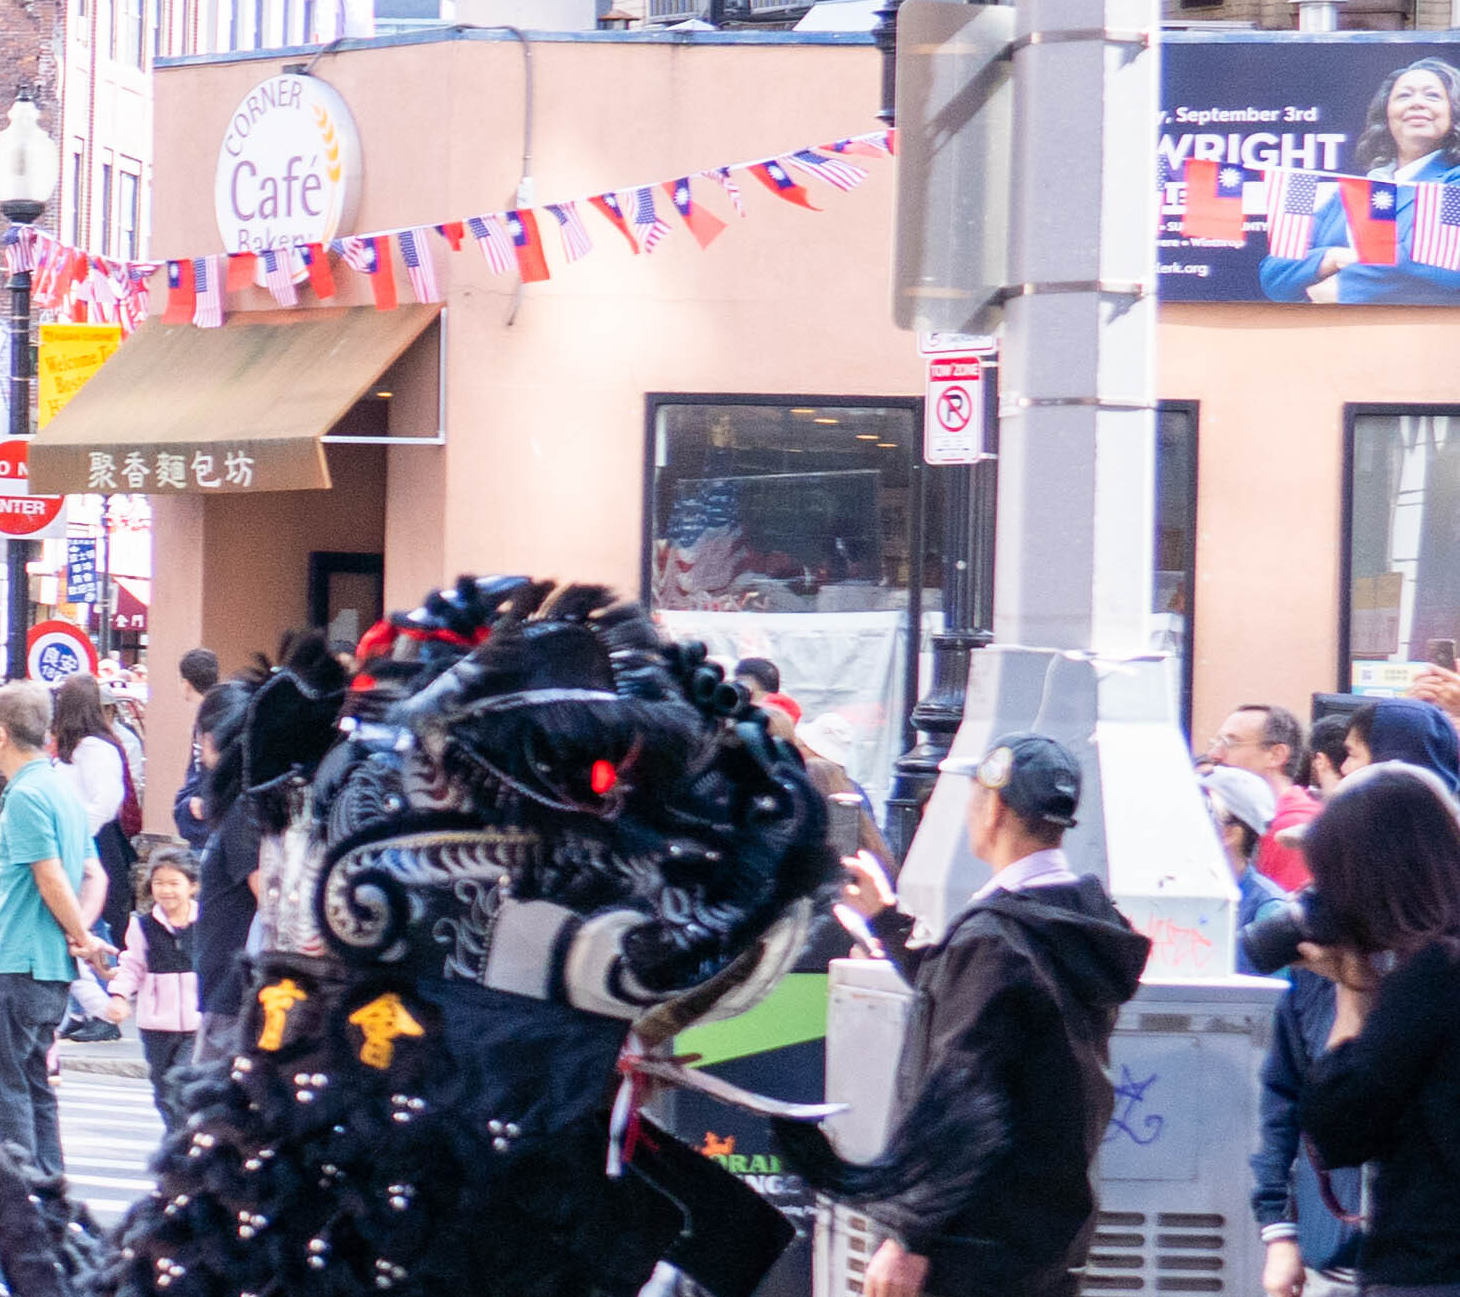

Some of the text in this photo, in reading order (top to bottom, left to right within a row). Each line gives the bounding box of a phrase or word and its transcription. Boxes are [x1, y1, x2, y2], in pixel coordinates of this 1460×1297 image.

[225, 79, 303, 157] CORNER
[1175, 107, 1318, 125] September 3rd
[1157, 133, 1347, 171] WRIGHT
[231, 155, 322, 222] Café
[1154, 262, 1210, 278] lerk.org
[930, 363, 980, 378] TOW ZONE
[88, 450, 255, 489] 聚香麵包坊
